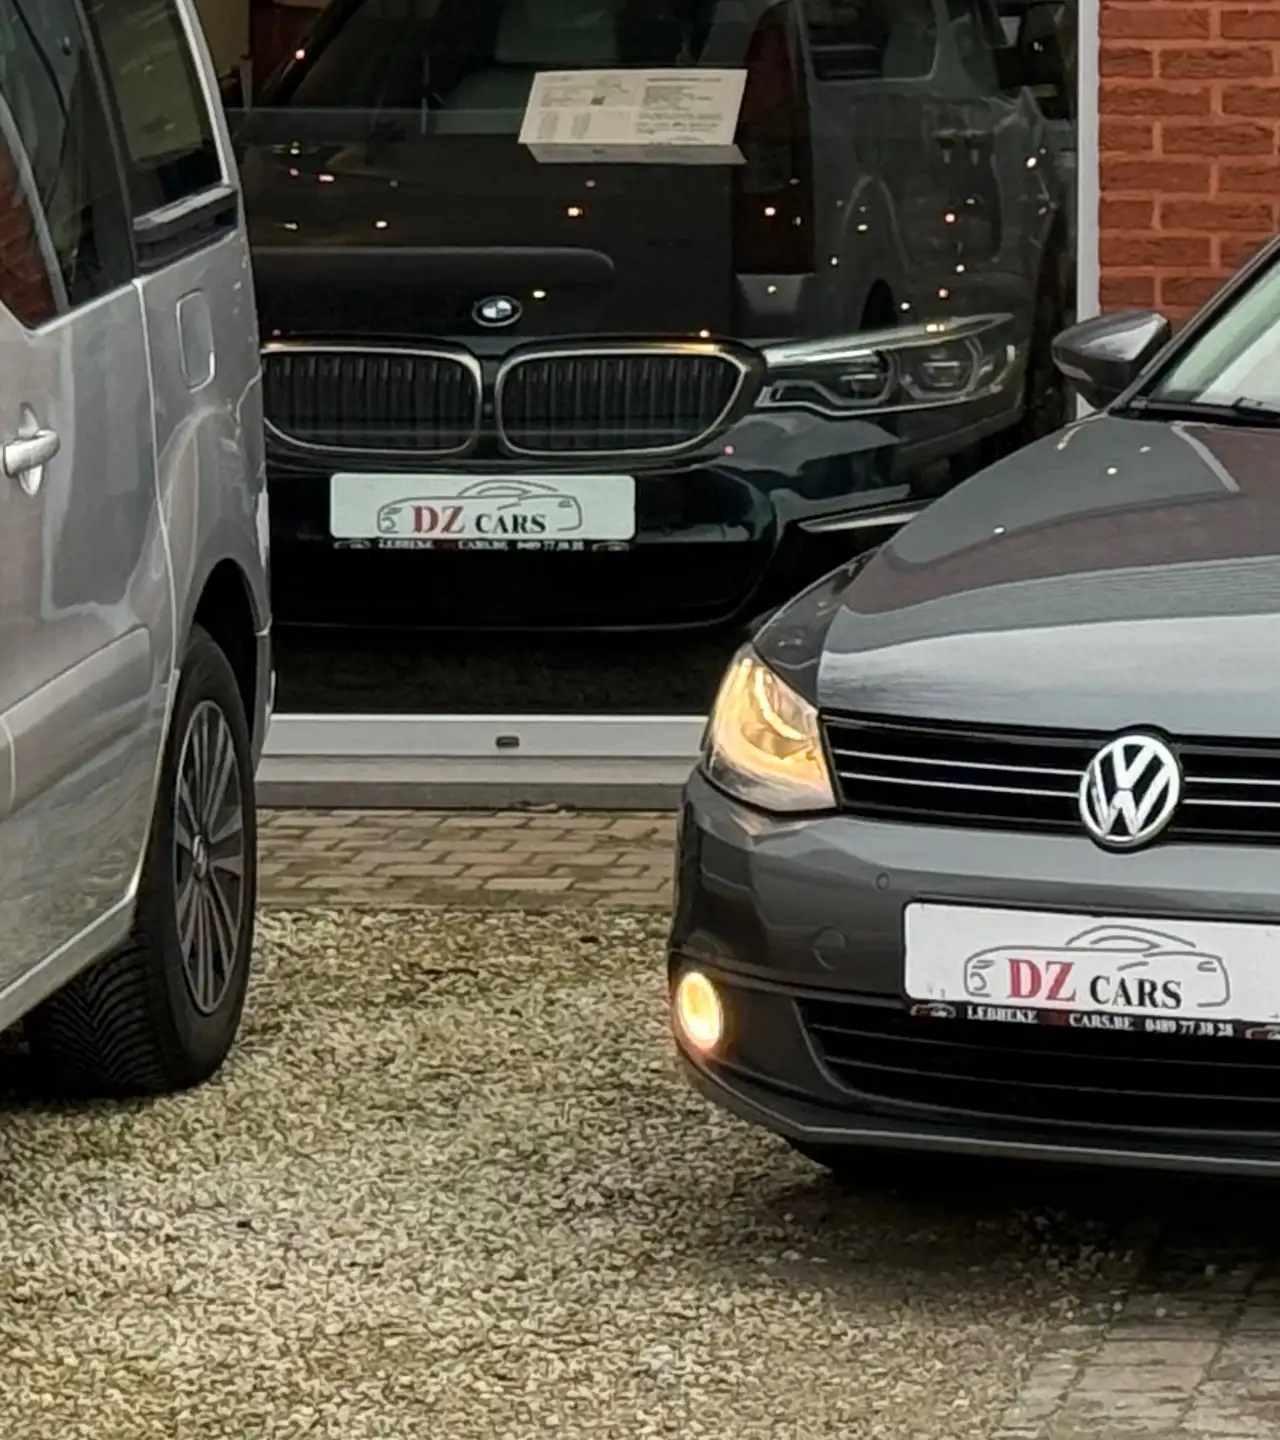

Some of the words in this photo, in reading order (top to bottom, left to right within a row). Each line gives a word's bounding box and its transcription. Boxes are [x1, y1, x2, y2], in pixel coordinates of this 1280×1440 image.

[411, 505, 466, 535] DZ
[475, 513, 548, 535] CARS
[1006, 957, 1077, 1003] DZ
[1088, 974, 1184, 1010] CARS
